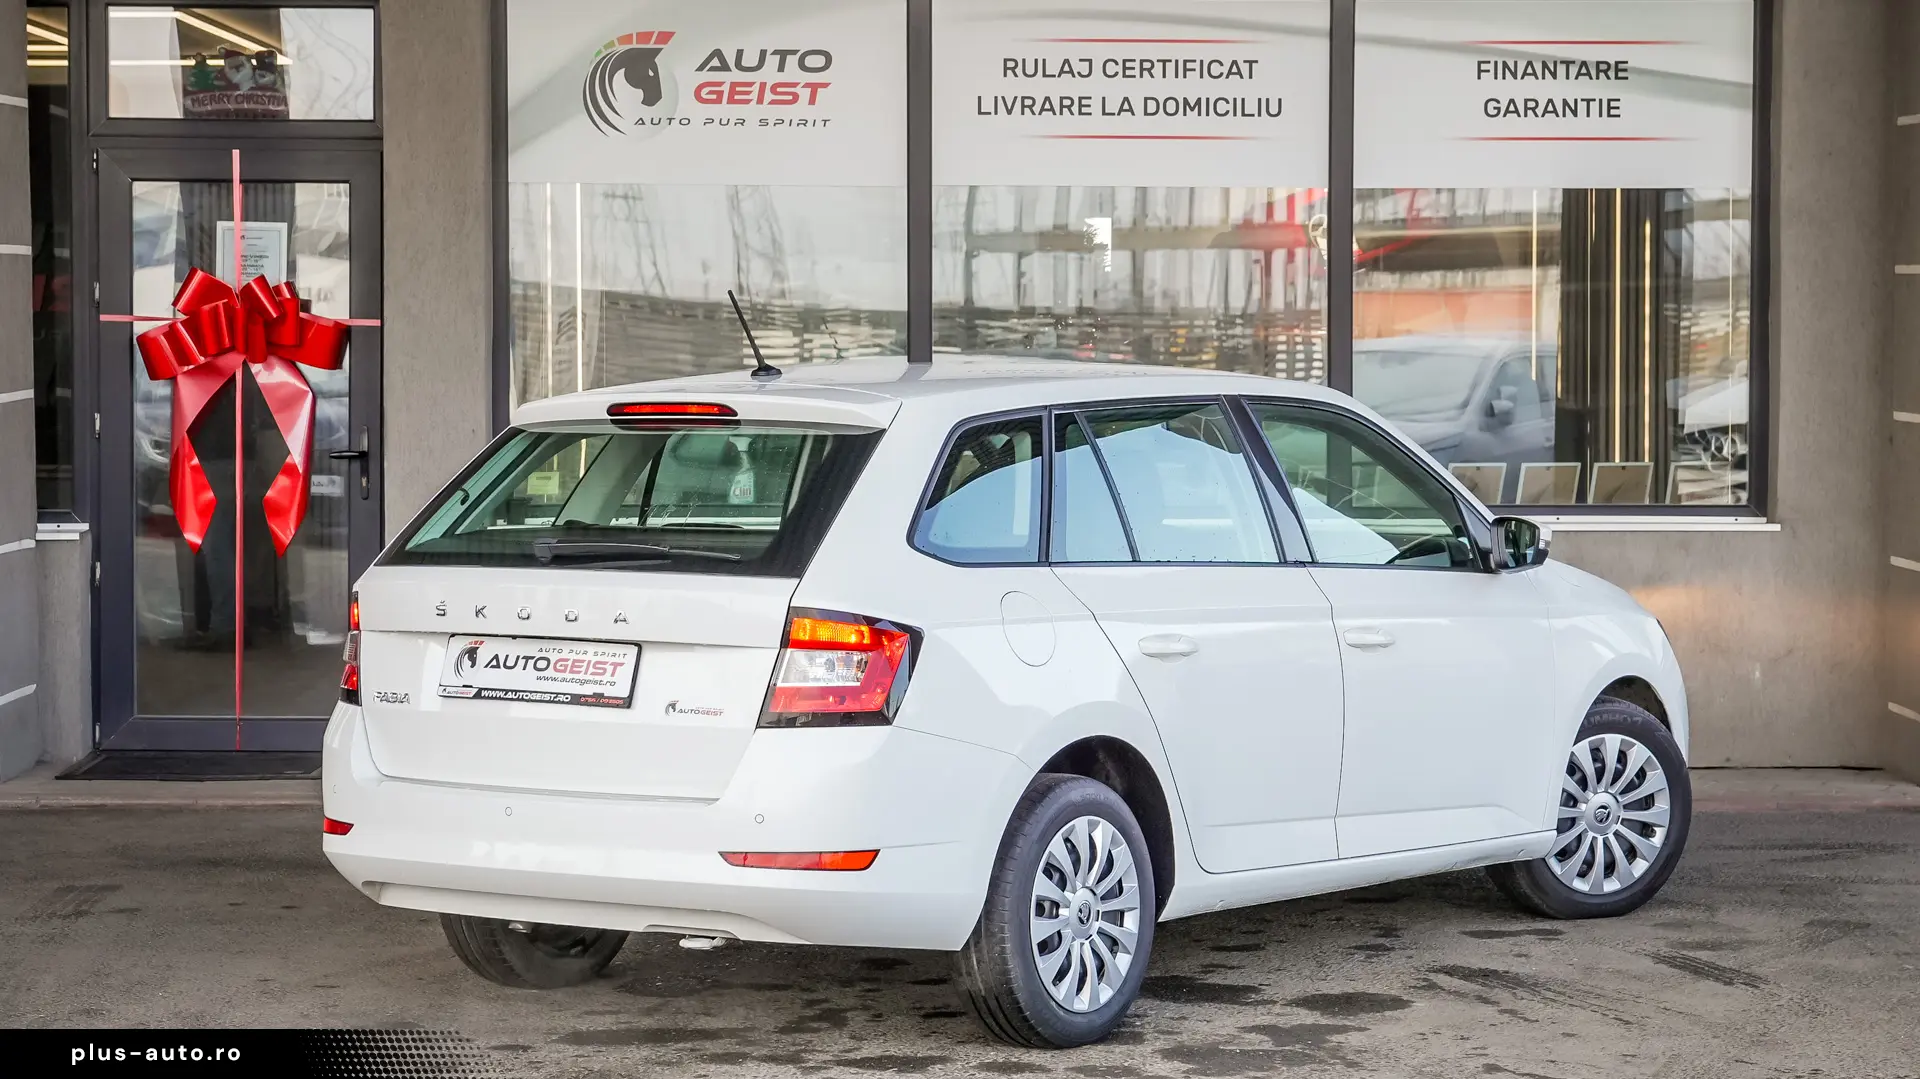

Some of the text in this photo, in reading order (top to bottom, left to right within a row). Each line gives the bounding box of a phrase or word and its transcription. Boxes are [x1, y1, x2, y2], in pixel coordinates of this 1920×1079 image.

[694, 48, 833, 74] AUTO
[1002, 57, 1259, 80] RULAJ CERTIFICAT
[1476, 59, 1629, 81] FINANTARE
[191, 93, 288, 108] MERRY CHRISTMA
[693, 81, 832, 106] GEIST
[977, 95, 1283, 118] LIVRARE LA DOMICILIU
[1483, 97, 1622, 119] GARANTIE
[633, 117, 831, 128] AUTO PUR SPIRIT
[483, 653, 626, 678] AUTOGEIST
[593, 651, 628, 659] SPIRIT
[536, 674, 617, 687] www.autogeist.ro
[372, 691, 411, 704] FABIA
[481, 689, 571, 702] WWW.AUTOGEIST.RO
